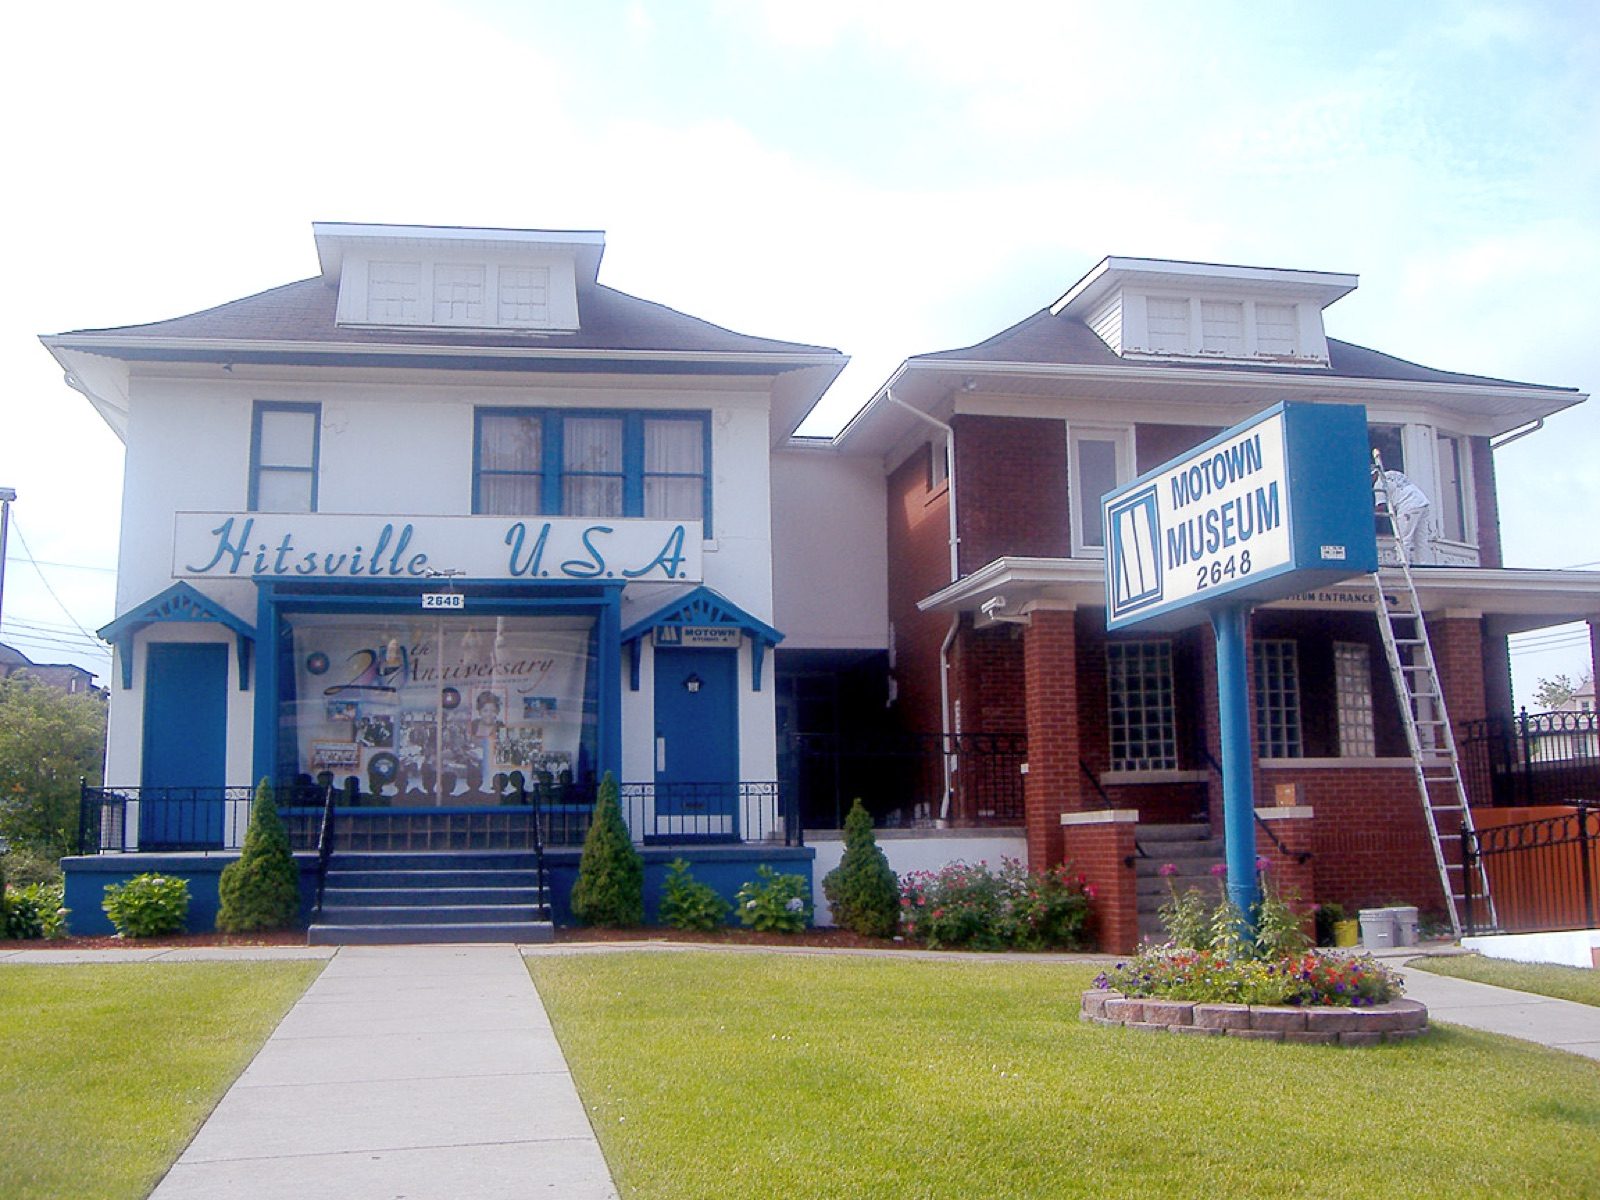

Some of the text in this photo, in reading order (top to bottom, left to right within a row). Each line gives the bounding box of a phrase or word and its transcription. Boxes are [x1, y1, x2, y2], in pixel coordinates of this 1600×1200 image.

[1171, 434, 1263, 510] MOTOWN
[186, 517, 428, 575] Hitsville
[1166, 480, 1281, 570] MUSEUM
[1196, 550, 1252, 590] 2648
[1319, 592, 1376, 603] ENTRANCE
